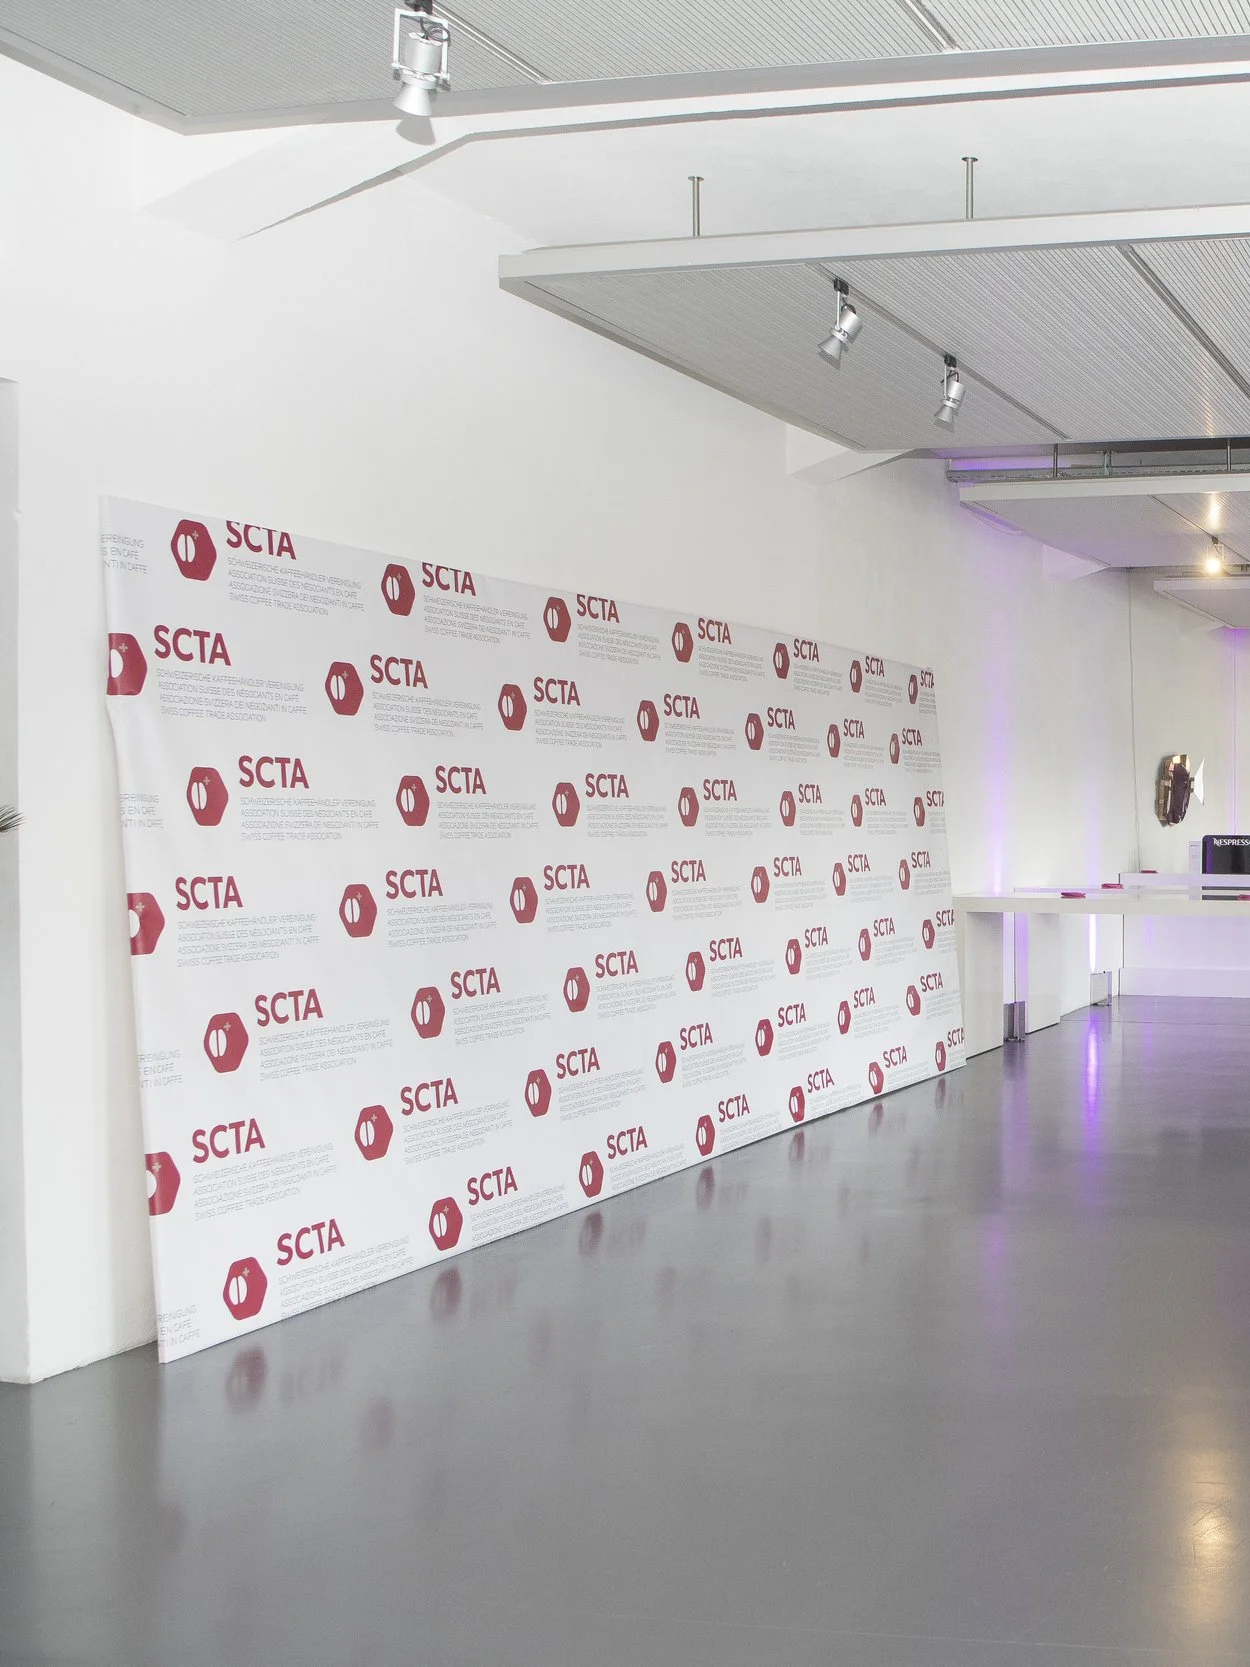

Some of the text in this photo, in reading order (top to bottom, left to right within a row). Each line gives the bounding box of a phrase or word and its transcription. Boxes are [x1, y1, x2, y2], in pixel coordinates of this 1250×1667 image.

[227, 521, 296, 560] SCTA
[422, 563, 477, 597] SCTA
[577, 594, 619, 623] SCTA
[697, 616, 732, 644] SCTA
[155, 625, 232, 666] SCTA
[793, 639, 821, 662] SCTA
[370, 655, 427, 688] SCTA
[863, 656, 884, 677] SCTA
[534, 677, 580, 704] SCTA
[664, 695, 700, 718] SCTA
[767, 708, 794, 728] SCTA
[845, 720, 864, 736] SCTA
[900, 728, 923, 745] SCTA
[239, 755, 308, 788] SCTA
[436, 766, 486, 795] SCTA
[585, 774, 628, 798] SCTA
[704, 780, 736, 800] SCTA
[800, 784, 820, 803] SCTA
[866, 789, 885, 805] SCTA
[672, 860, 704, 882] SCTA
[774, 856, 801, 878] SCTA
[848, 855, 871, 872] SCTA
[912, 850, 931, 868] SCTA
[386, 869, 442, 900] SCTA
[544, 864, 590, 891] SCTA
[176, 876, 243, 911] SCTA
[806, 928, 828, 948] SCTA
[875, 918, 895, 935] SCTA
[710, 938, 743, 963] SCTA
[595, 950, 638, 979] SCTA
[451, 968, 501, 999] SCTA
[919, 972, 943, 992] SCTA
[256, 989, 323, 1027] SCTA
[854, 988, 876, 1008] SCTA
[777, 1004, 807, 1028] SCTA
[680, 1024, 712, 1050] SCTA
[557, 1048, 599, 1079] SCTA
[883, 1046, 908, 1069] SCTA
[808, 1068, 833, 1093] SCTA
[401, 1078, 457, 1115] SCTA
[719, 1095, 750, 1123] SCTA
[193, 1119, 266, 1163] SCTA
[608, 1126, 648, 1159] SCTA
[467, 1168, 518, 1206] SCTA
[278, 1219, 345, 1265] SCTA
